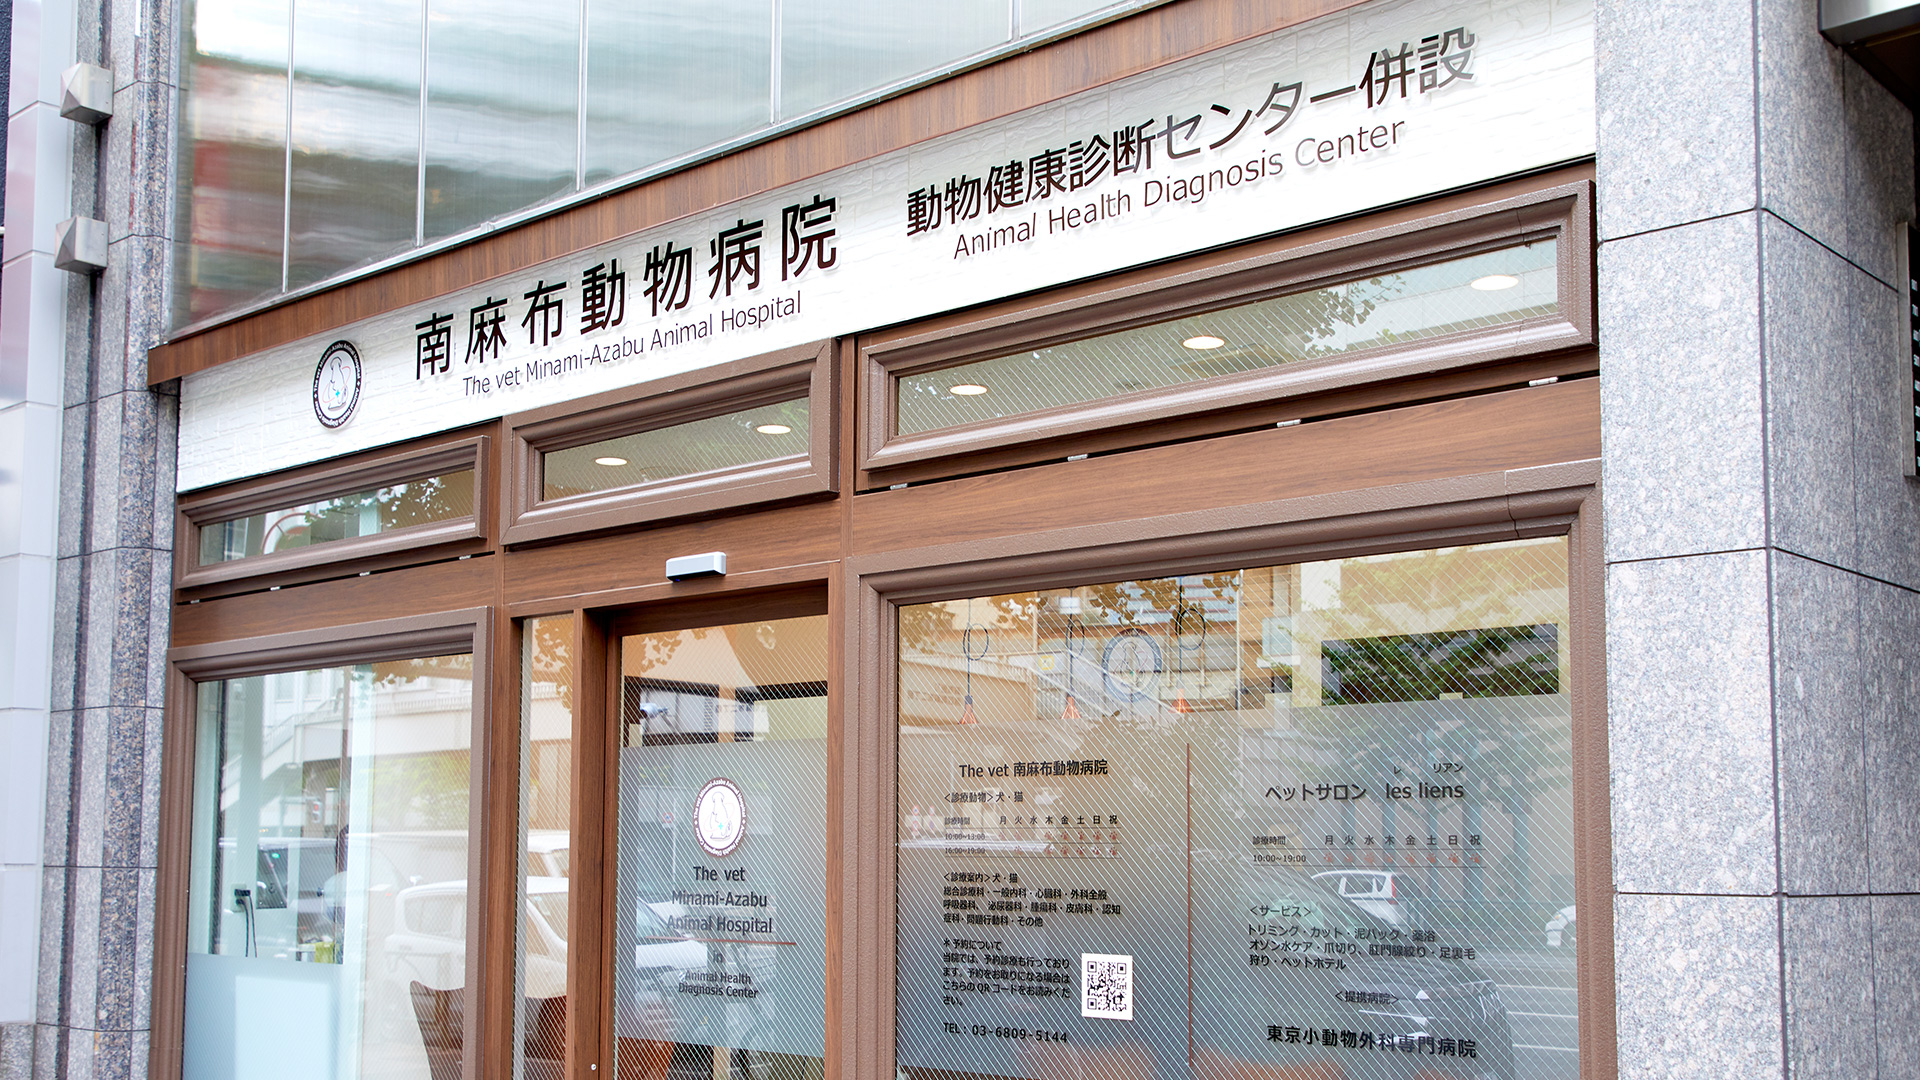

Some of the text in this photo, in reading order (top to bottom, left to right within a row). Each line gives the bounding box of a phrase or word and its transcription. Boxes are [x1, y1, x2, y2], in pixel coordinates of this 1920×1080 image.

[907, 27, 1475, 238] 動物健康診断センター併設
[954, 117, 1405, 259] Animal Health Diagnosis Center
[414, 194, 839, 380] 南麻布動物病院
[462, 291, 802, 397] The vet Minami-Azabu Animal Hospital
[958, 759, 1108, 777] The vet 南麻布動物病院
[1433, 762, 1464, 774] リアン
[1265, 782, 1464, 801] ペットサロン les liens
[1000, 815, 1007, 824] 月
[1014, 815, 1022, 824] 火
[1029, 815, 1038, 824] 水
[1044, 815, 1054, 824] 木
[1060, 815, 1069, 824] 金
[1076, 815, 1085, 824] 土
[1092, 815, 1101, 824] 日
[1109, 815, 1118, 824] 祝
[1324, 835, 1334, 845] 月
[1344, 835, 1354, 845] 火
[1364, 835, 1374, 845] 水
[1384, 835, 1395, 845] 木
[1405, 835, 1416, 845] 金
[1426, 835, 1437, 845] 土
[1448, 835, 1458, 845] 日
[1469, 835, 1481, 845] 祝
[693, 866, 745, 881] The vet
[671, 890, 768, 908] Minami-Azabu
[667, 915, 773, 935] Animal Hospital
[684, 970, 751, 985] Animal Health
[678, 983, 759, 999] Diagnosis Center
[972, 1024, 1068, 1043] 03-6809-5144
[1266, 1025, 1477, 1059] 東京小動物外科専門病院
